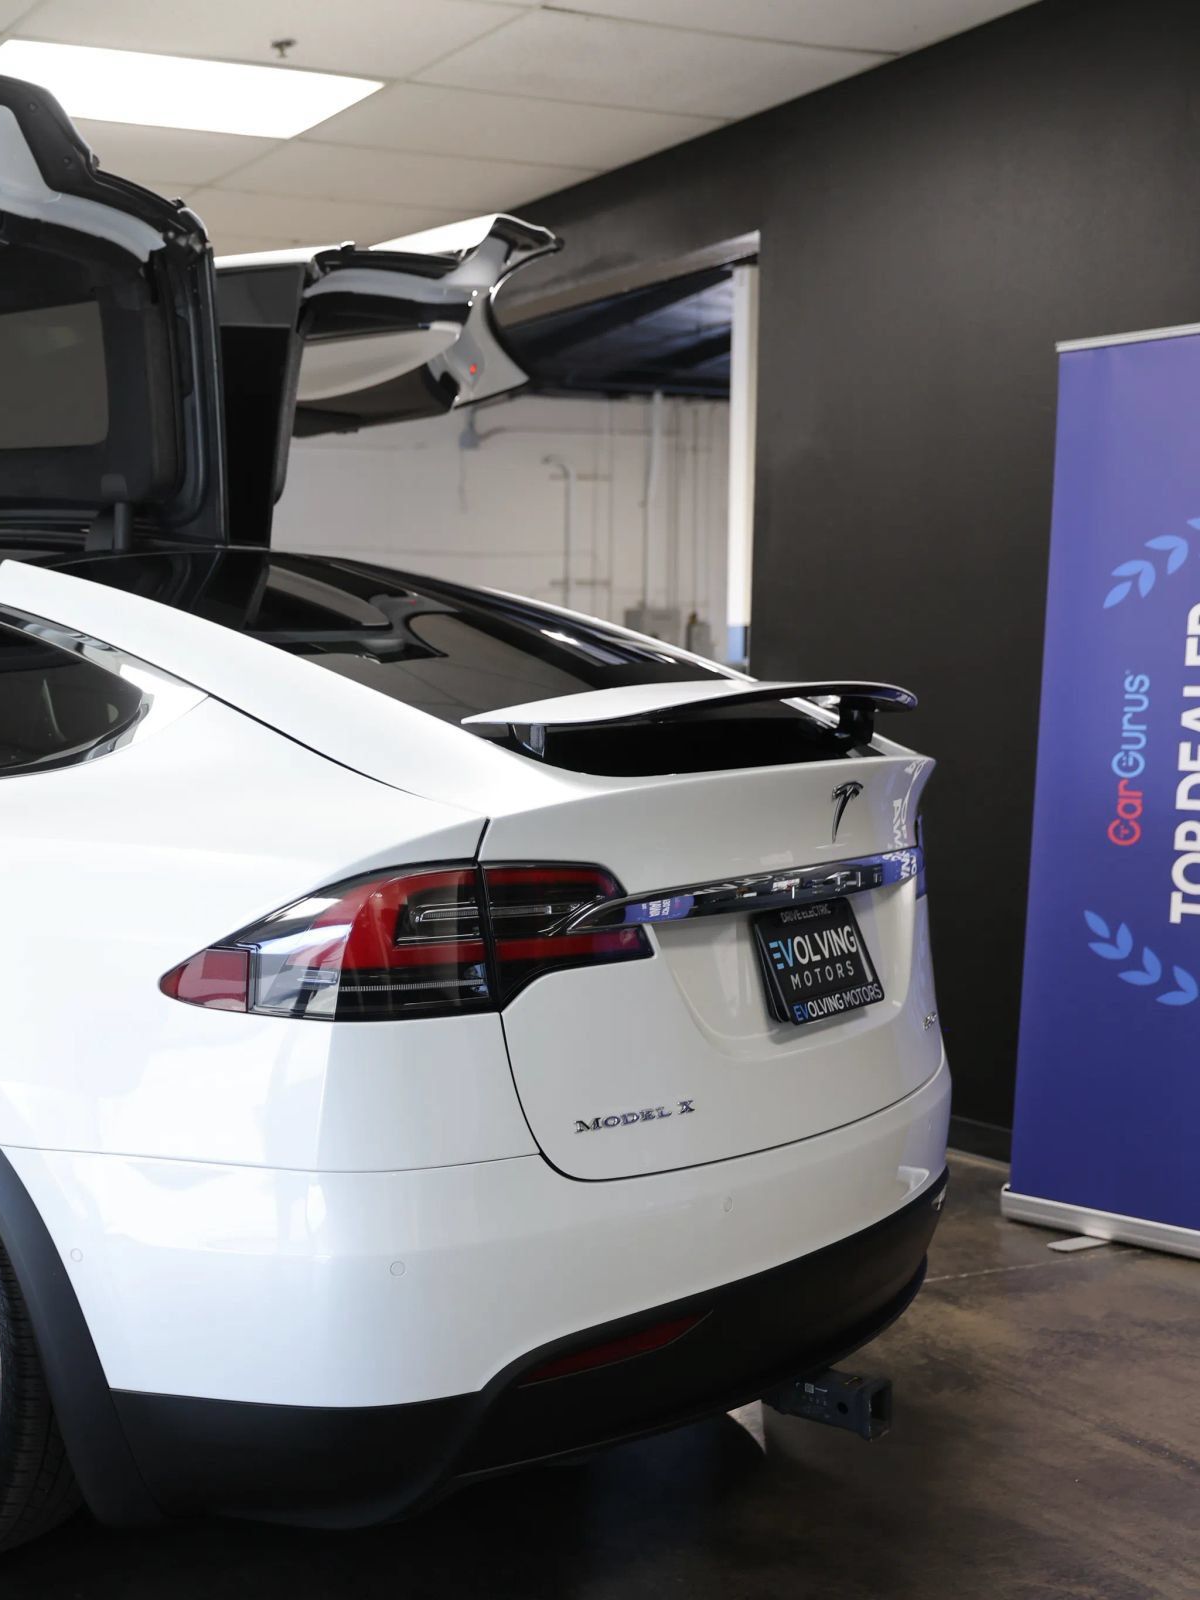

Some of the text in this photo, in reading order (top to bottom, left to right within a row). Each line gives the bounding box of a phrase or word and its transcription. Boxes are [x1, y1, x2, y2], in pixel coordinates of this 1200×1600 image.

[769, 925, 857, 970] EVOLVING
[790, 960, 854, 990] MOTORS
[793, 983, 882, 1021] EVOLVING MOTORS
[575, 1100, 695, 1134] MODEL X
